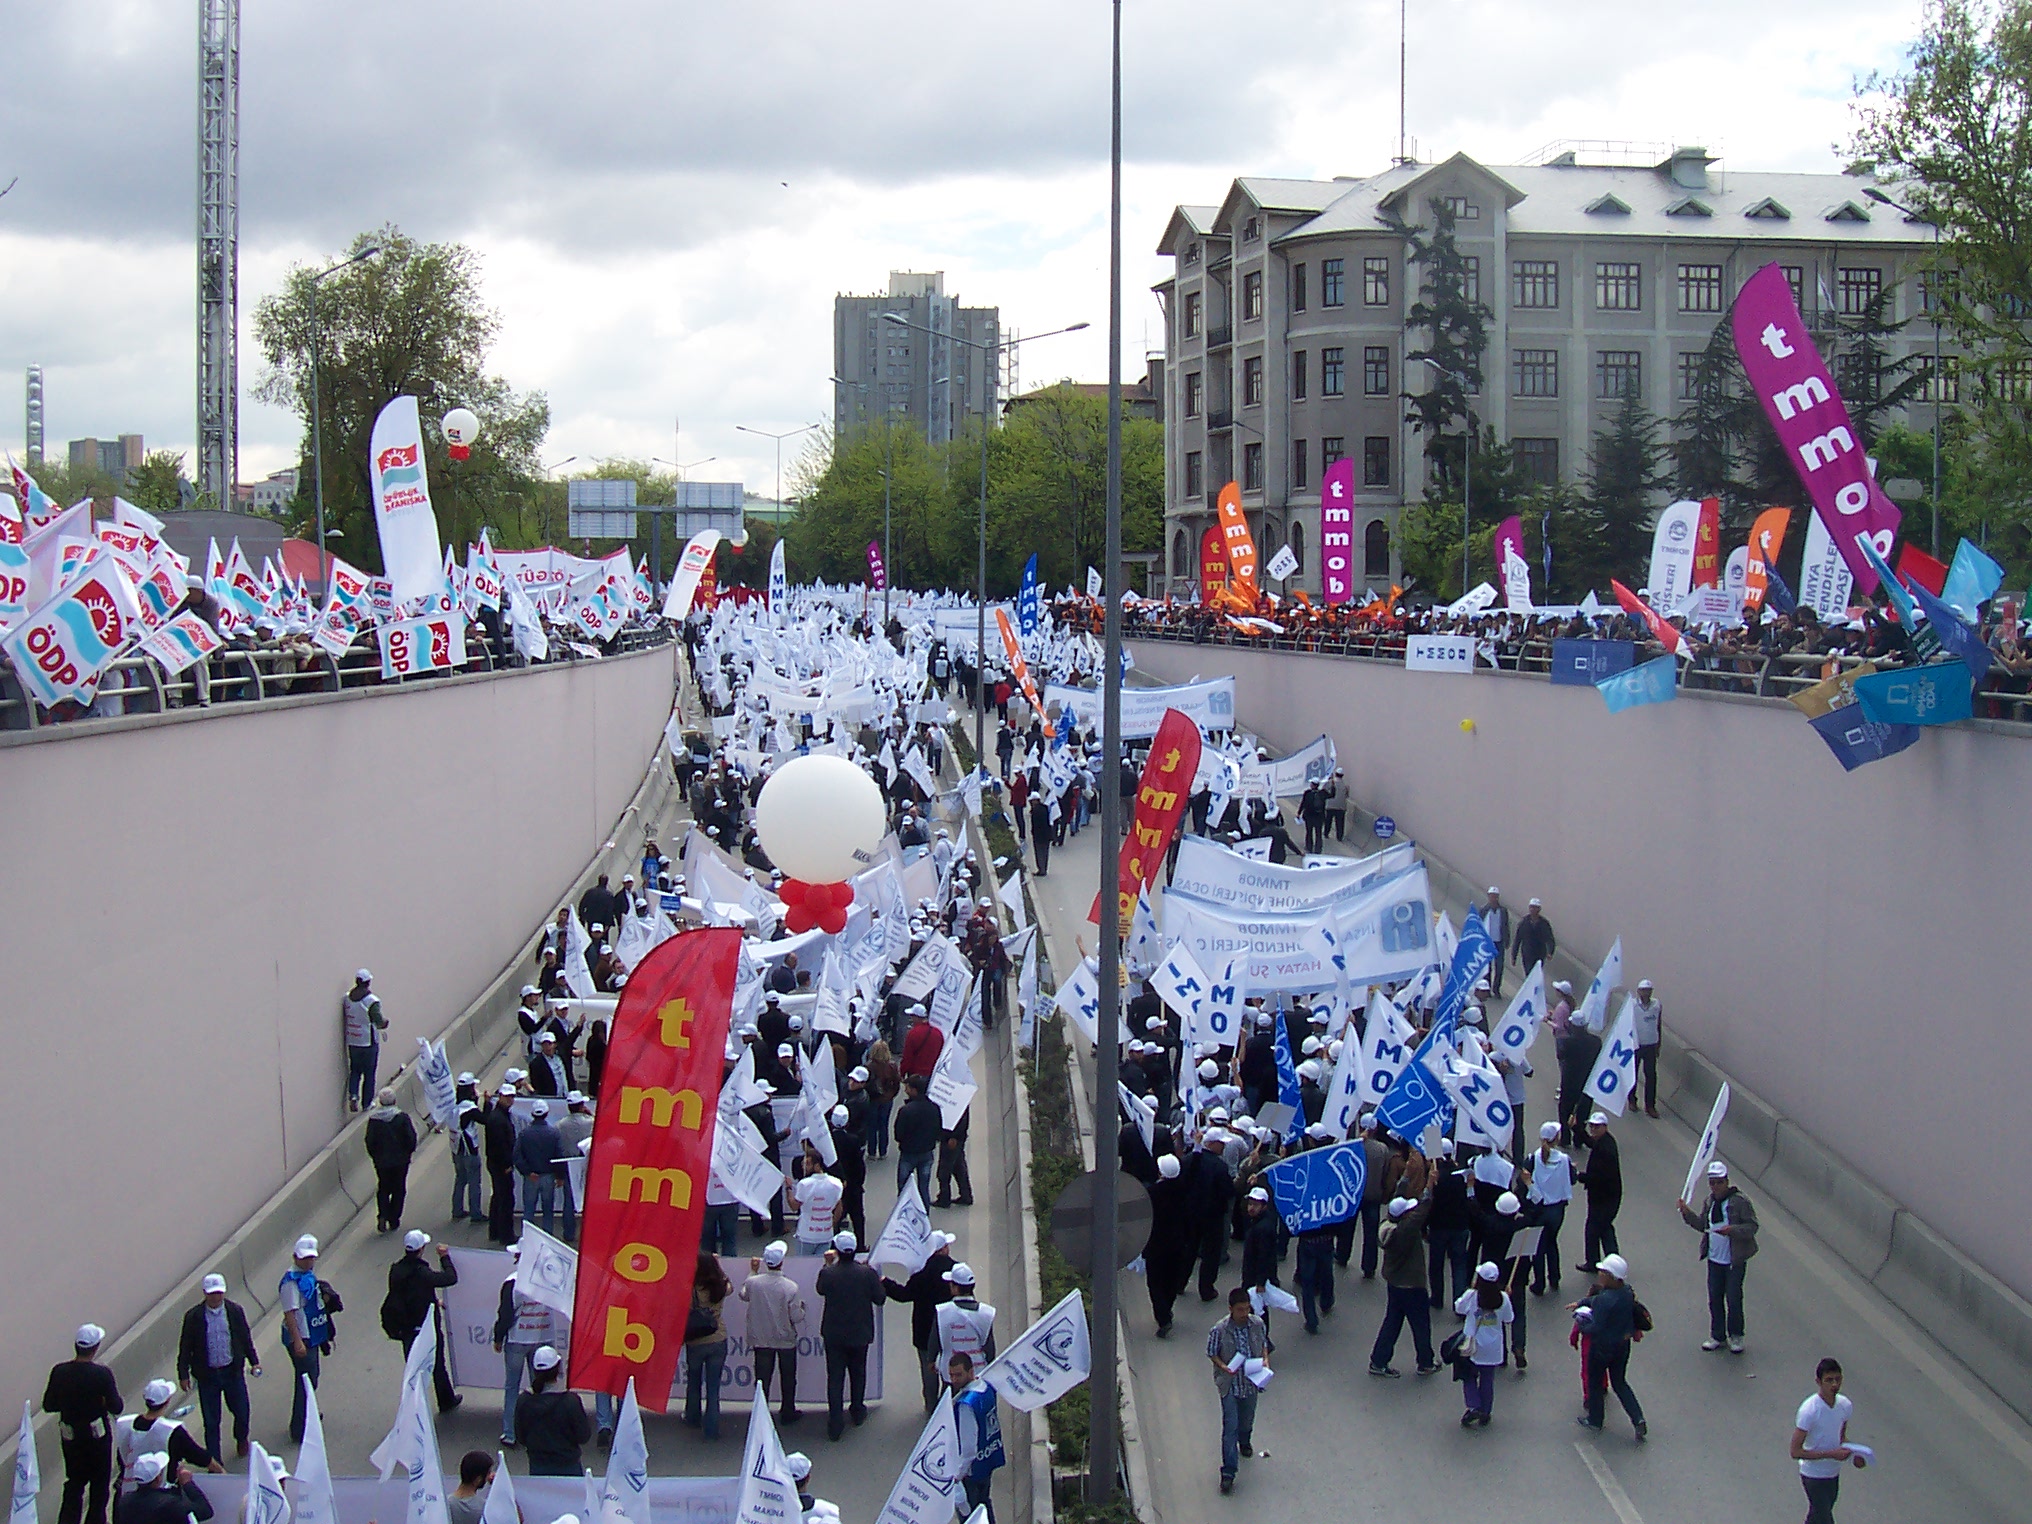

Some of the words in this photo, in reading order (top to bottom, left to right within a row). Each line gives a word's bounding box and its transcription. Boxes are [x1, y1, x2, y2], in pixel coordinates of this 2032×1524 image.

[1760, 322, 1894, 569] tmmob
[1205, 541, 1225, 609] tmmo
[1225, 502, 1254, 585] tmmo
[1325, 480, 1350, 594] tmmob
[27, 624, 79, 686] ÖDP
[389, 630, 409, 672] ÖDP
[602, 998, 704, 1363] tmmob
